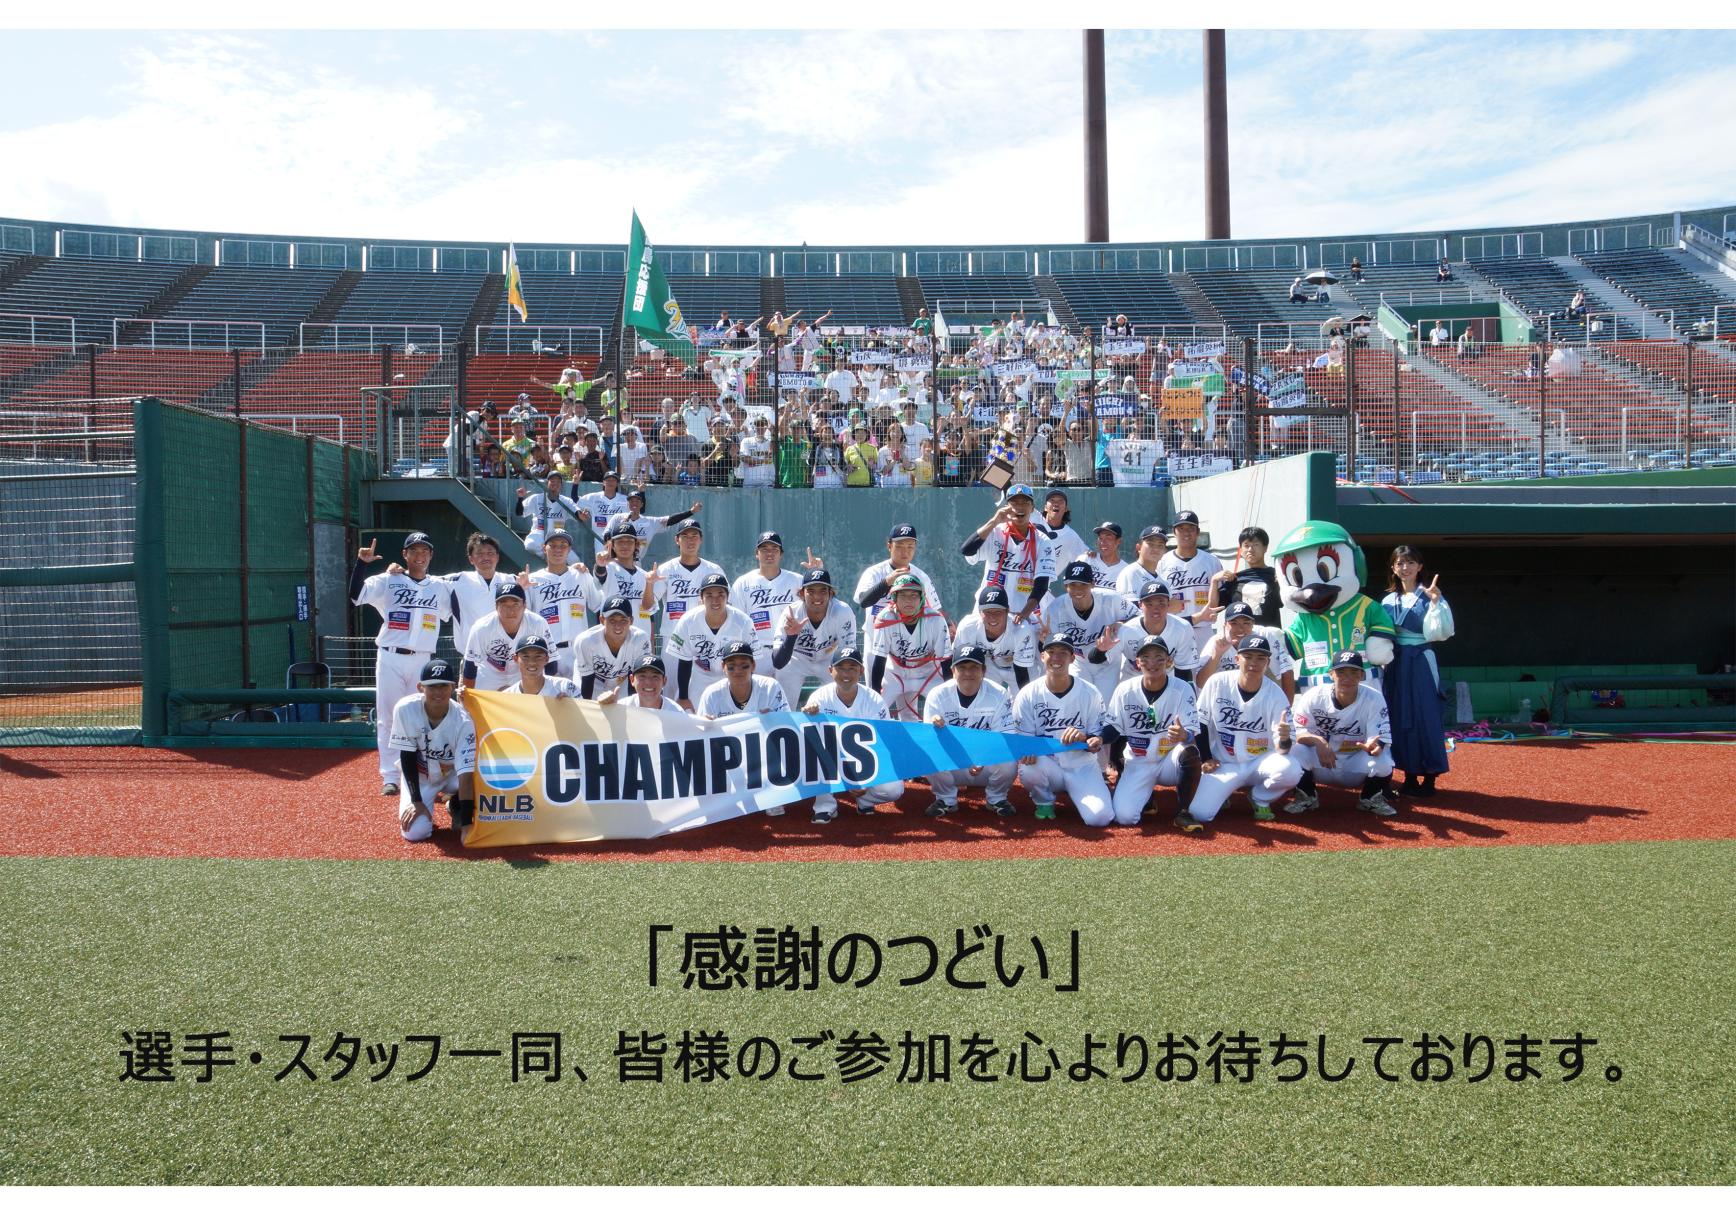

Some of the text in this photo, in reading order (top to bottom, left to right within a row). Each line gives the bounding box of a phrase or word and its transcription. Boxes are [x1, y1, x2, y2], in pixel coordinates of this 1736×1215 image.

[1123, 451, 1142, 467] 41
[1167, 570, 1209, 591] Birds
[393, 588, 438, 610] Birds
[539, 582, 584, 604] Birds
[749, 588, 794, 609] Birds
[1219, 706, 1266, 733] Birds
[545, 724, 875, 803] CHAMPIONS
[480, 795, 534, 813] NLB
